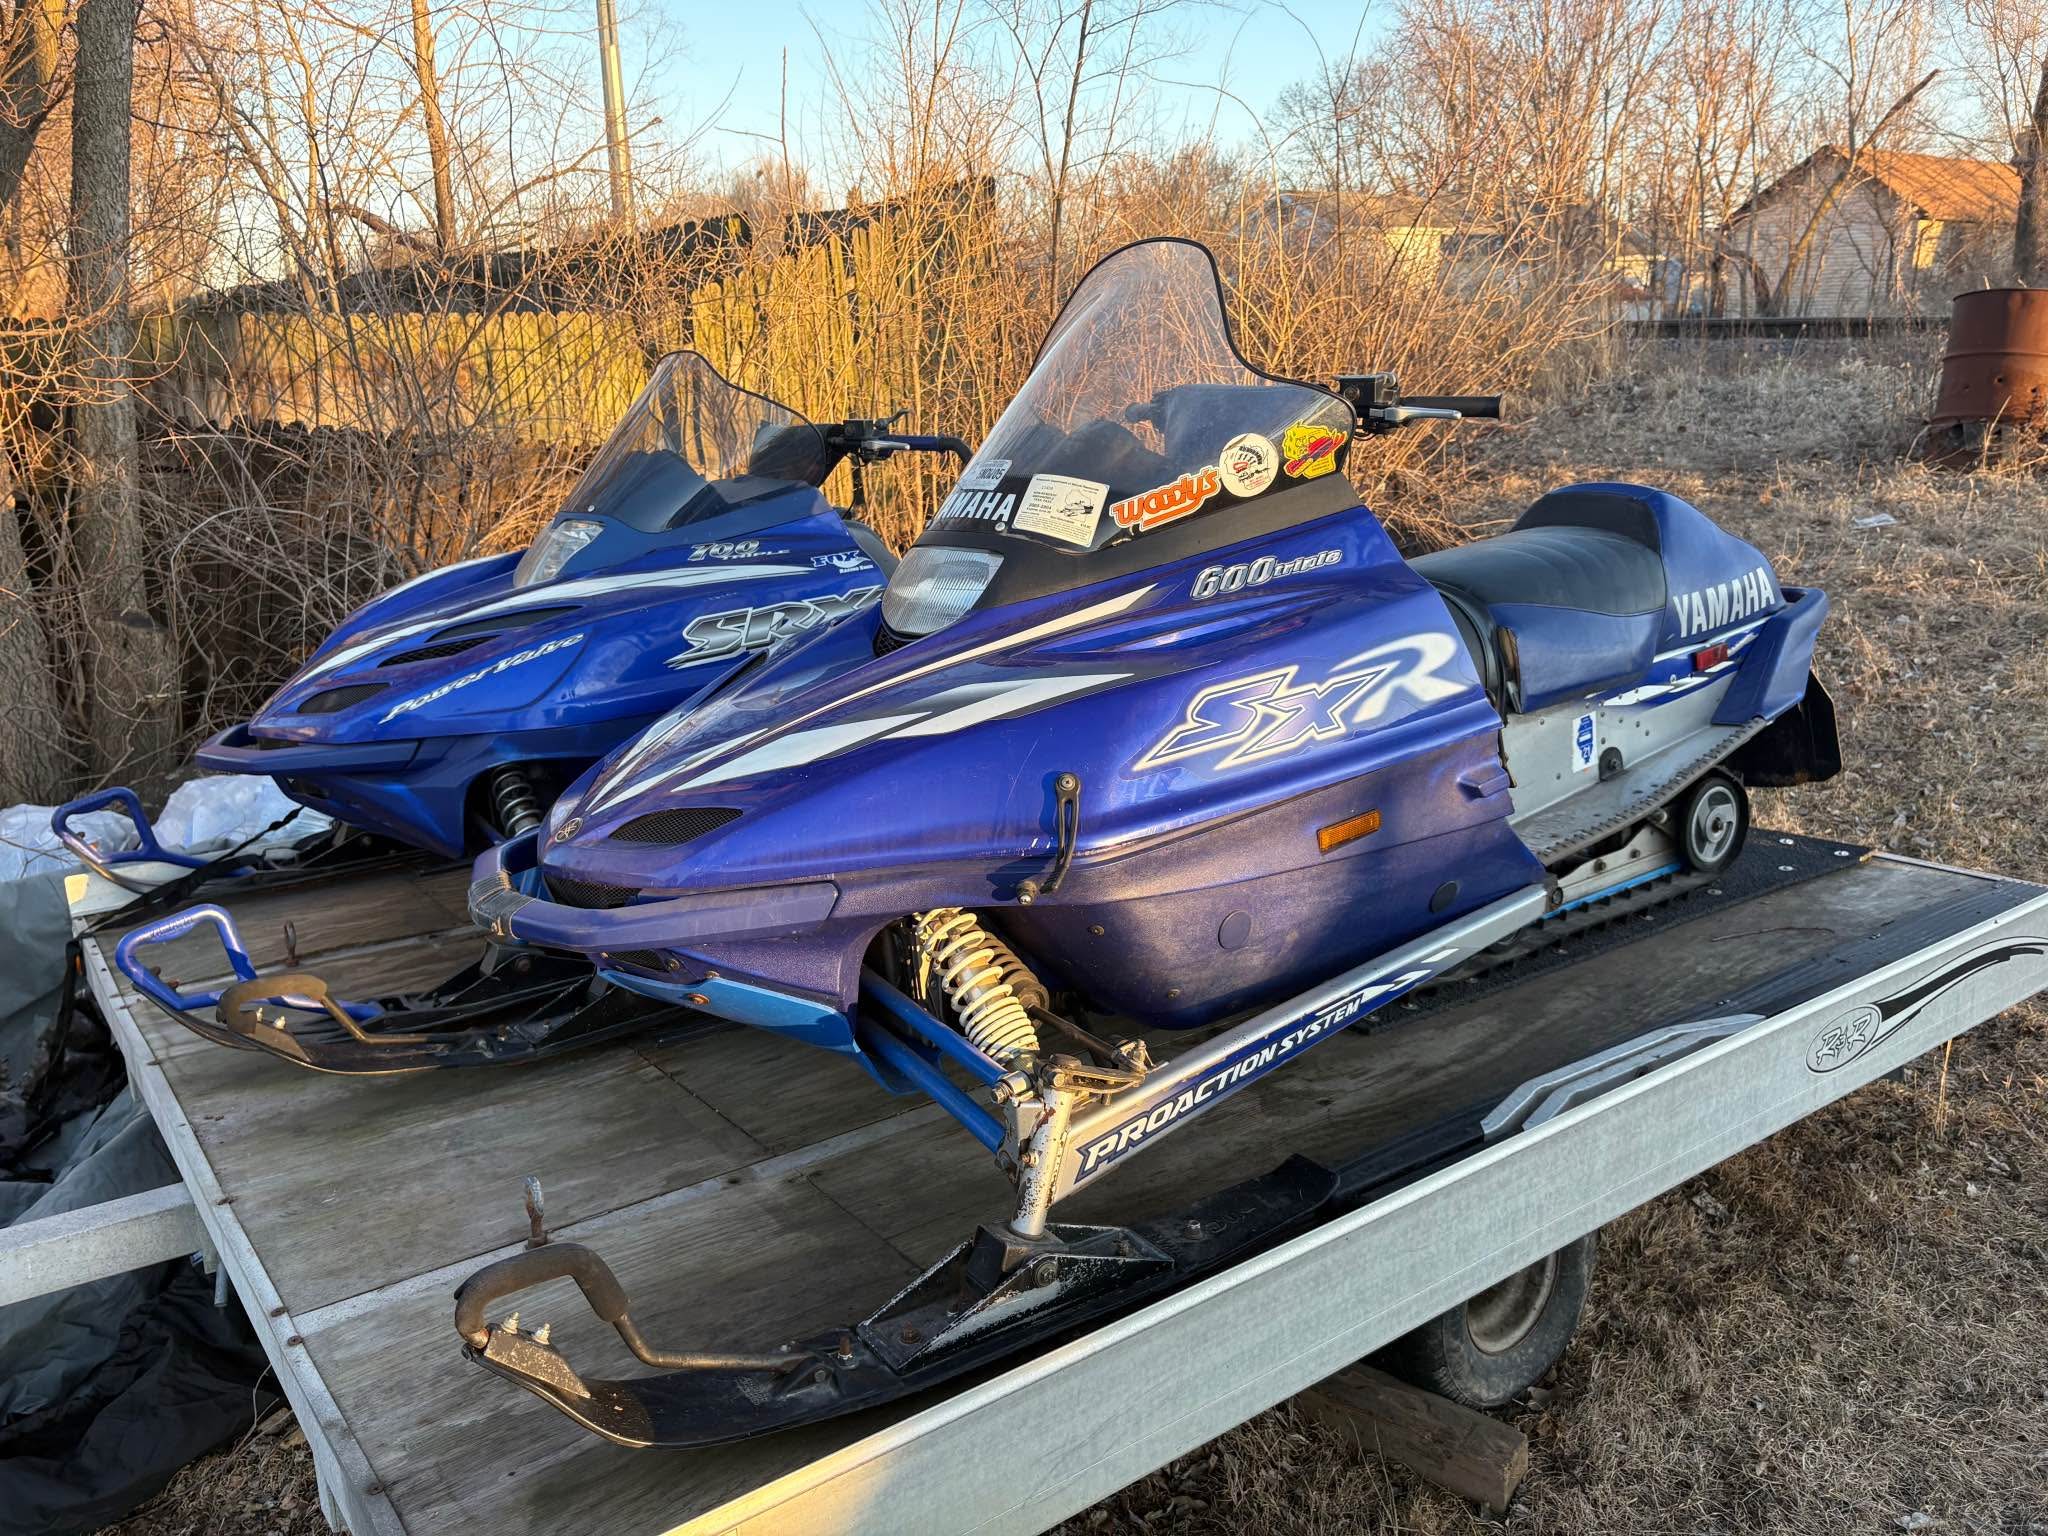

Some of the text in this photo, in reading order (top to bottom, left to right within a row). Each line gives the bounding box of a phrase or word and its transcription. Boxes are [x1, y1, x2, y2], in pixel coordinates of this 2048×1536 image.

[938, 491, 1016, 521] AMAHA
[1113, 470, 1218, 526] woody's
[688, 540, 760, 561] 700
[811, 550, 862, 569] FOX
[663, 584, 884, 670] SRX
[1673, 567, 1775, 639] YAMAHA
[378, 633, 585, 725] Power Valve
[1084, 1000, 1362, 1172] PROACTION SYSTEM
